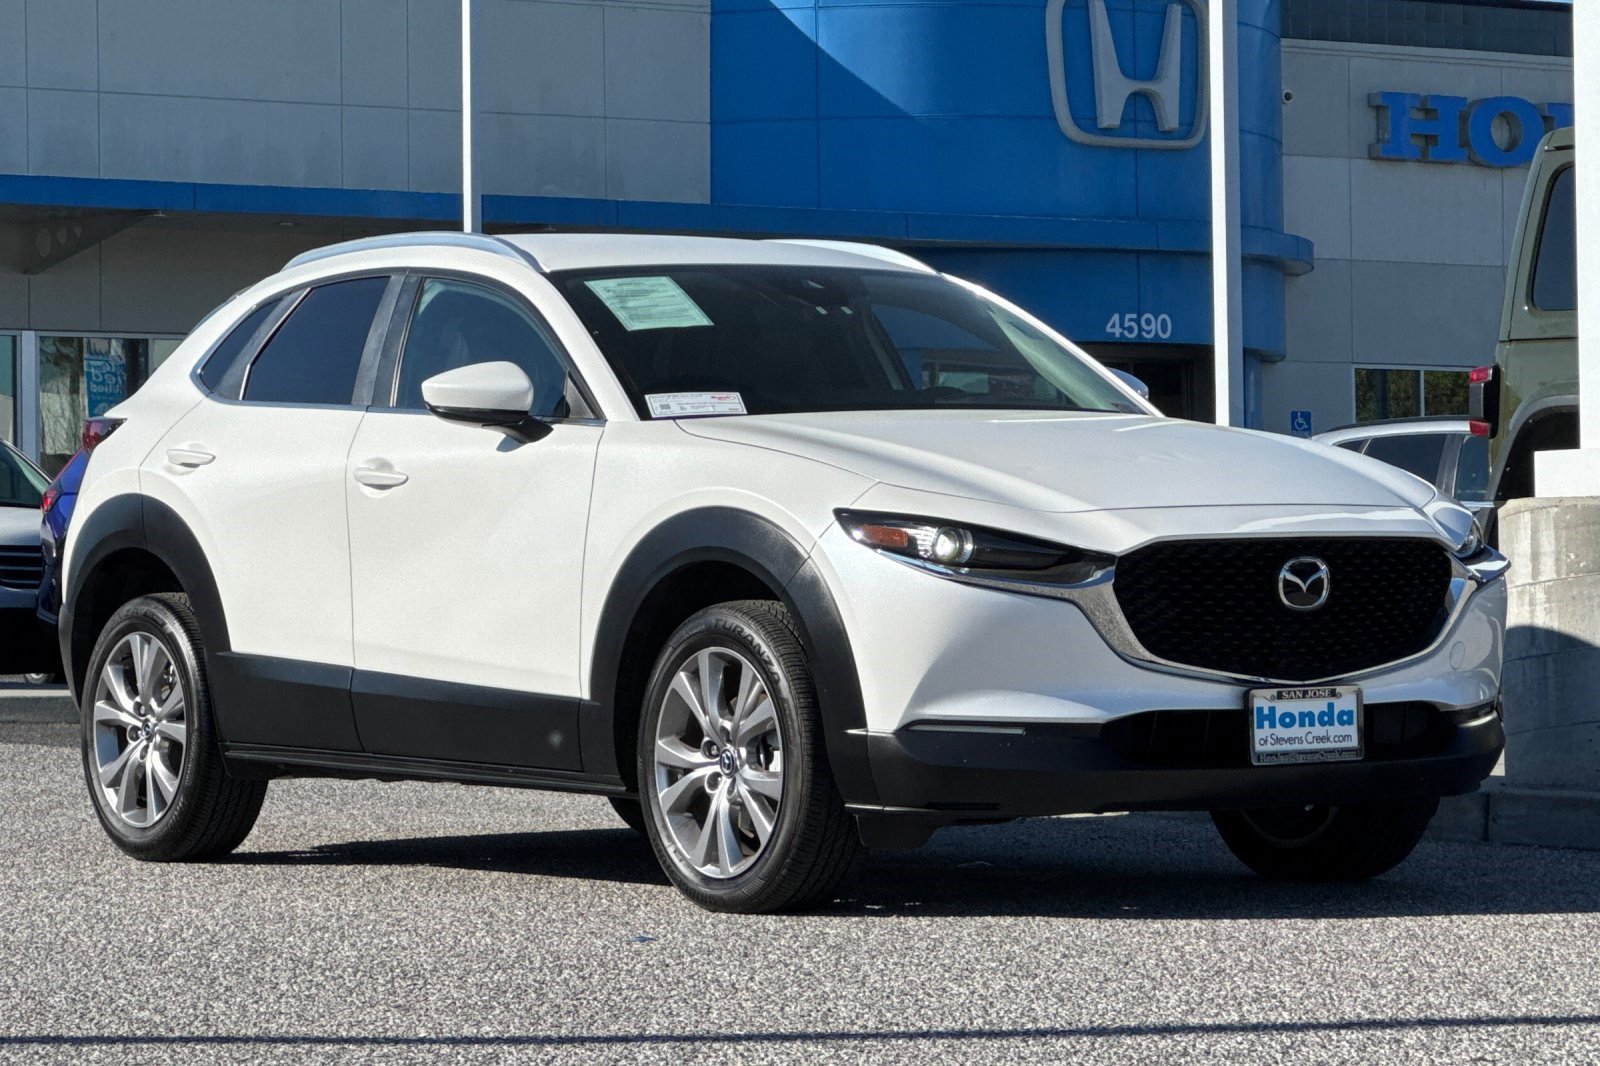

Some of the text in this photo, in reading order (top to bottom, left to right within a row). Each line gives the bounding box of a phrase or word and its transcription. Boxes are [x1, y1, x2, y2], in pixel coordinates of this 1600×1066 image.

[1105, 312, 1172, 339] 4590
[1282, 689, 1332, 699] SAN JOSE
[1255, 702, 1354, 729] Honda
[1258, 729, 1353, 746] of Stevens Creek.com
